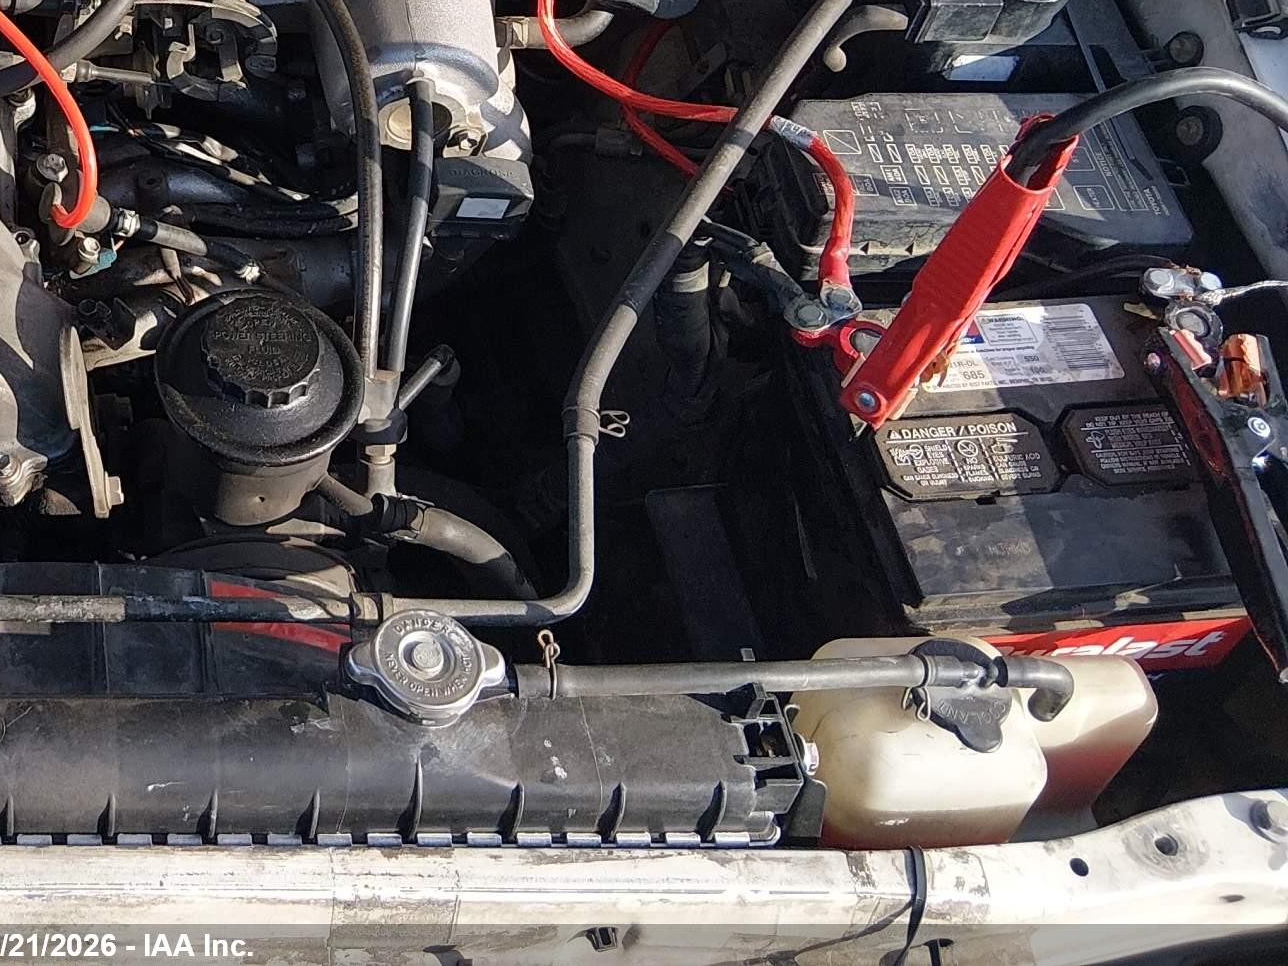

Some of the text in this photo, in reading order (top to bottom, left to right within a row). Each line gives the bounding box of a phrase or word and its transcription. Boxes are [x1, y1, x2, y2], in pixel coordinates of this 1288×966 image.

[1143, 188, 1162, 215] TOYOTA
[962, 370, 986, 380] 685
[901, 422, 1018, 440] DANGER / POISON
[923, 444, 948, 452] SHIELD
[393, 617, 450, 635] DANGER
[384, 651, 409, 685] NEVER
[409, 683, 439, 698] OPEN
